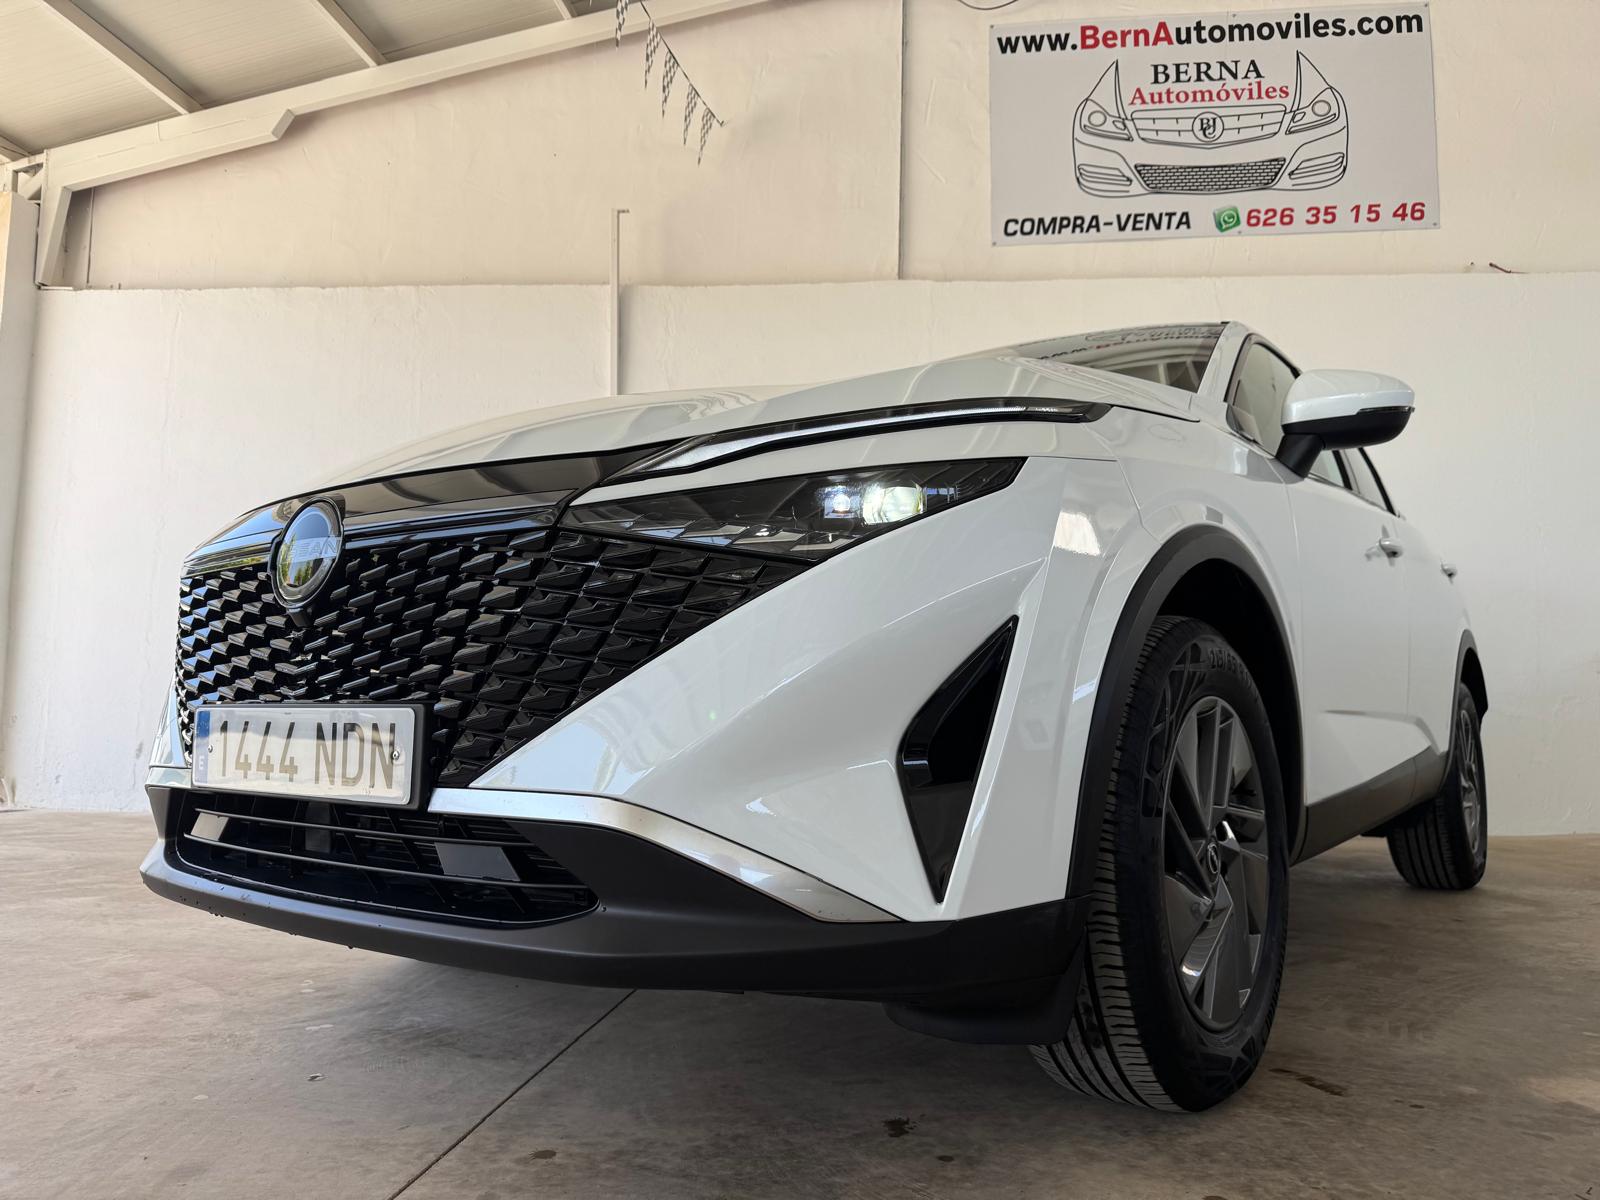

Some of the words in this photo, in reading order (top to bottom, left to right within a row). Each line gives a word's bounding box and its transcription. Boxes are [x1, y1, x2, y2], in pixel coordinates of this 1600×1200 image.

[997, 13, 1424, 54] www.BernAutomoviles.com
[1151, 59, 1265, 85] BERNA
[1128, 80, 1290, 107] Automóviles
[1003, 212, 1191, 236] COMPRA-VENTA
[1247, 208, 1295, 228] 626
[1306, 206, 1338, 225] 35
[1350, 204, 1381, 223] 15
[1393, 202, 1426, 222] 46
[220, 721, 298, 783] 1444
[315, 722, 396, 788] NDN
